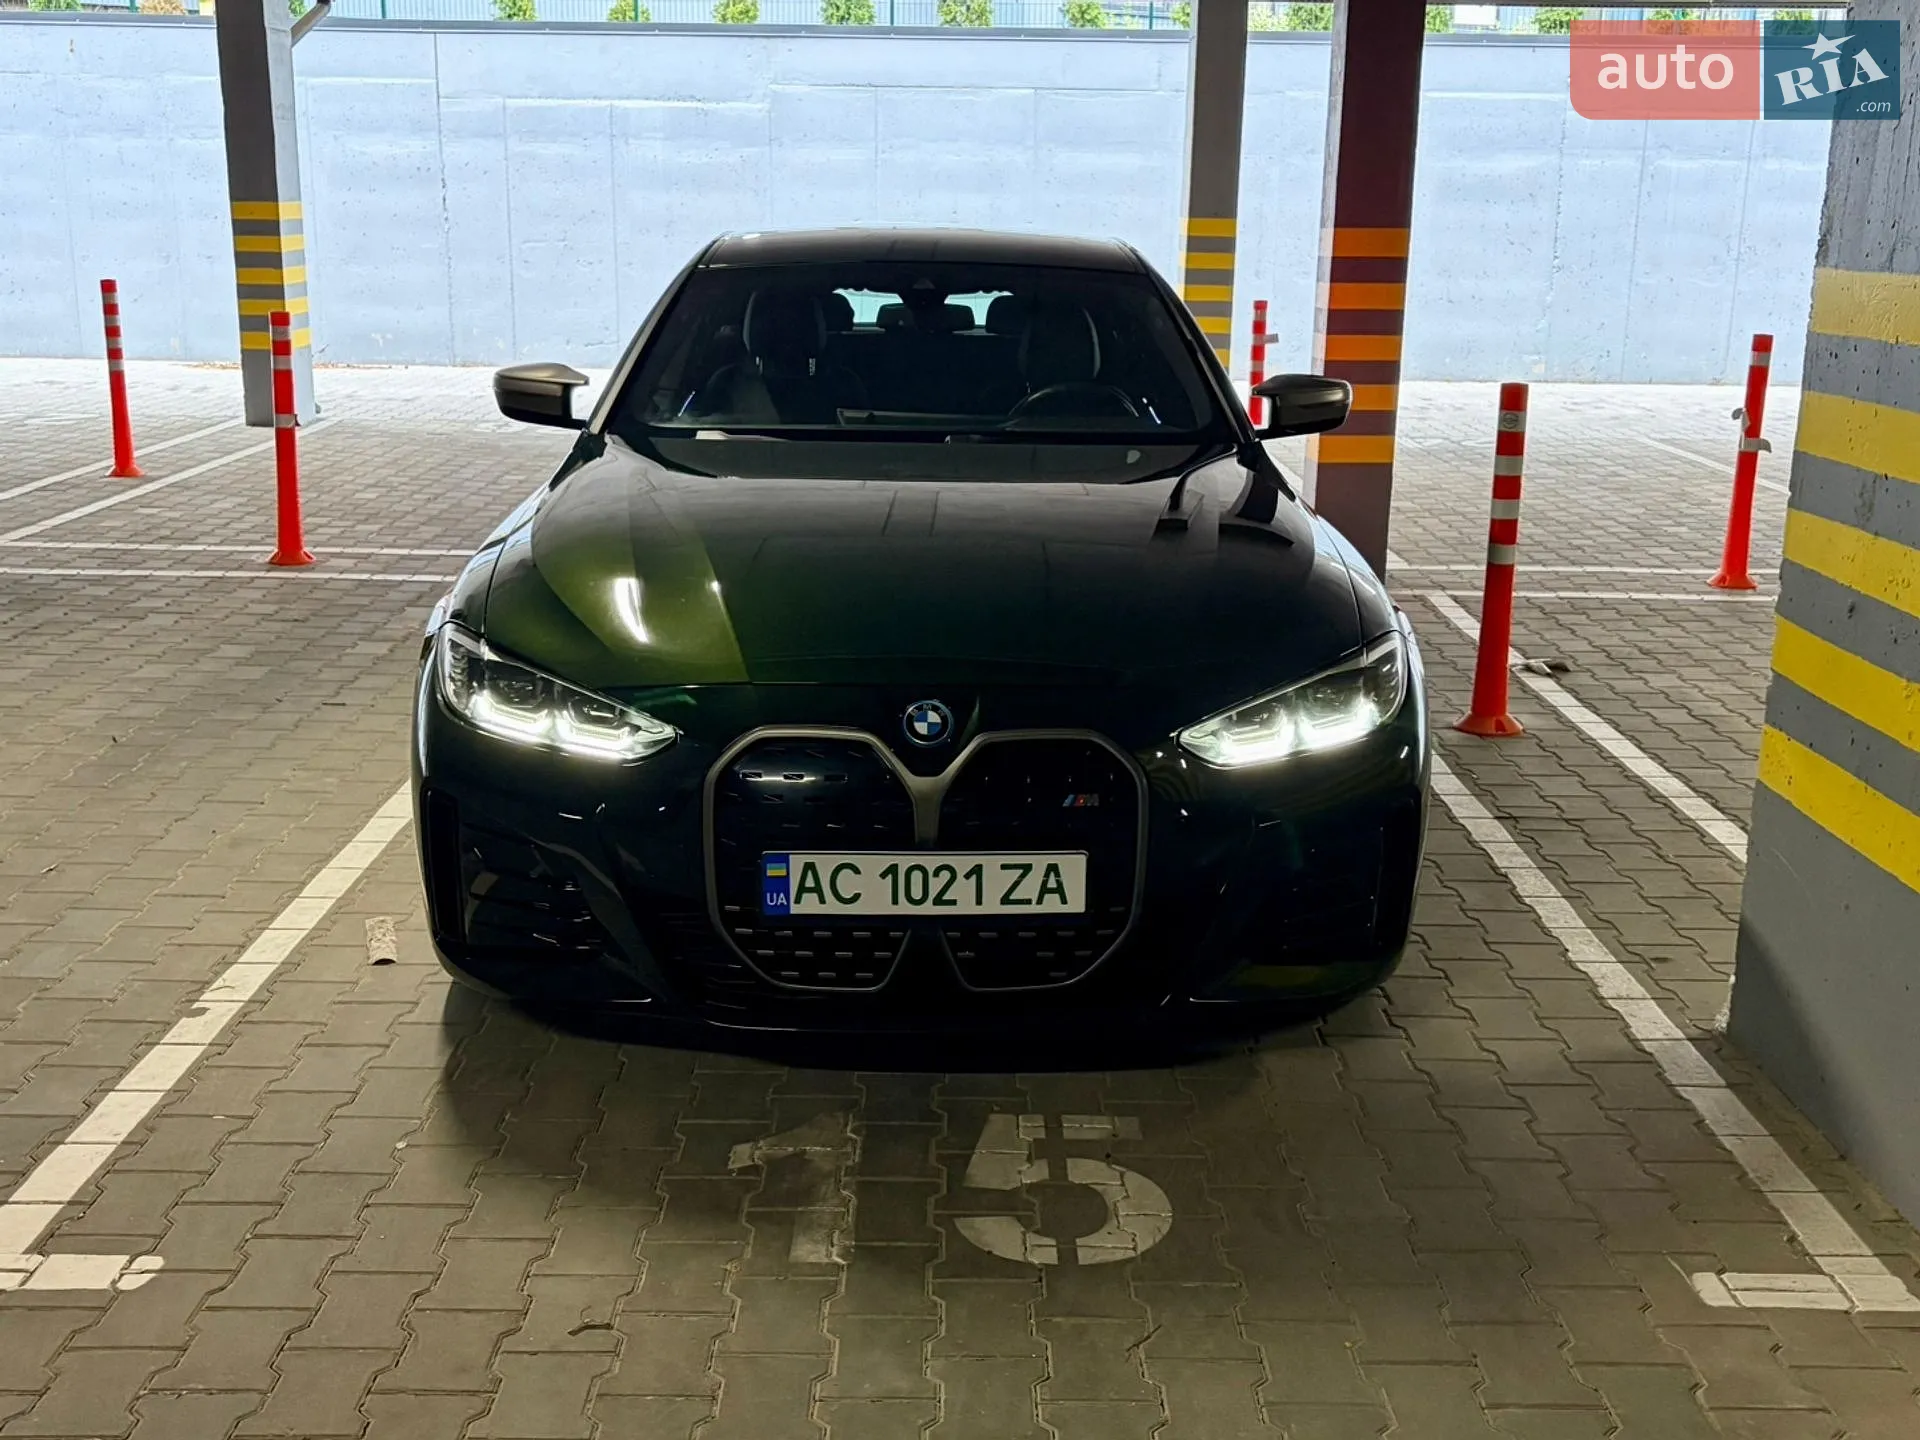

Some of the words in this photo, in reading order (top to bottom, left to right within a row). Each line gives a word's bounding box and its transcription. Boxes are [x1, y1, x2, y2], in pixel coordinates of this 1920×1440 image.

[766, 892, 787, 906] UA
[793, 861, 862, 906] AC
[879, 862, 983, 907] 1021
[999, 862, 1069, 906] ZA
[728, 1112, 1173, 1266] 15
